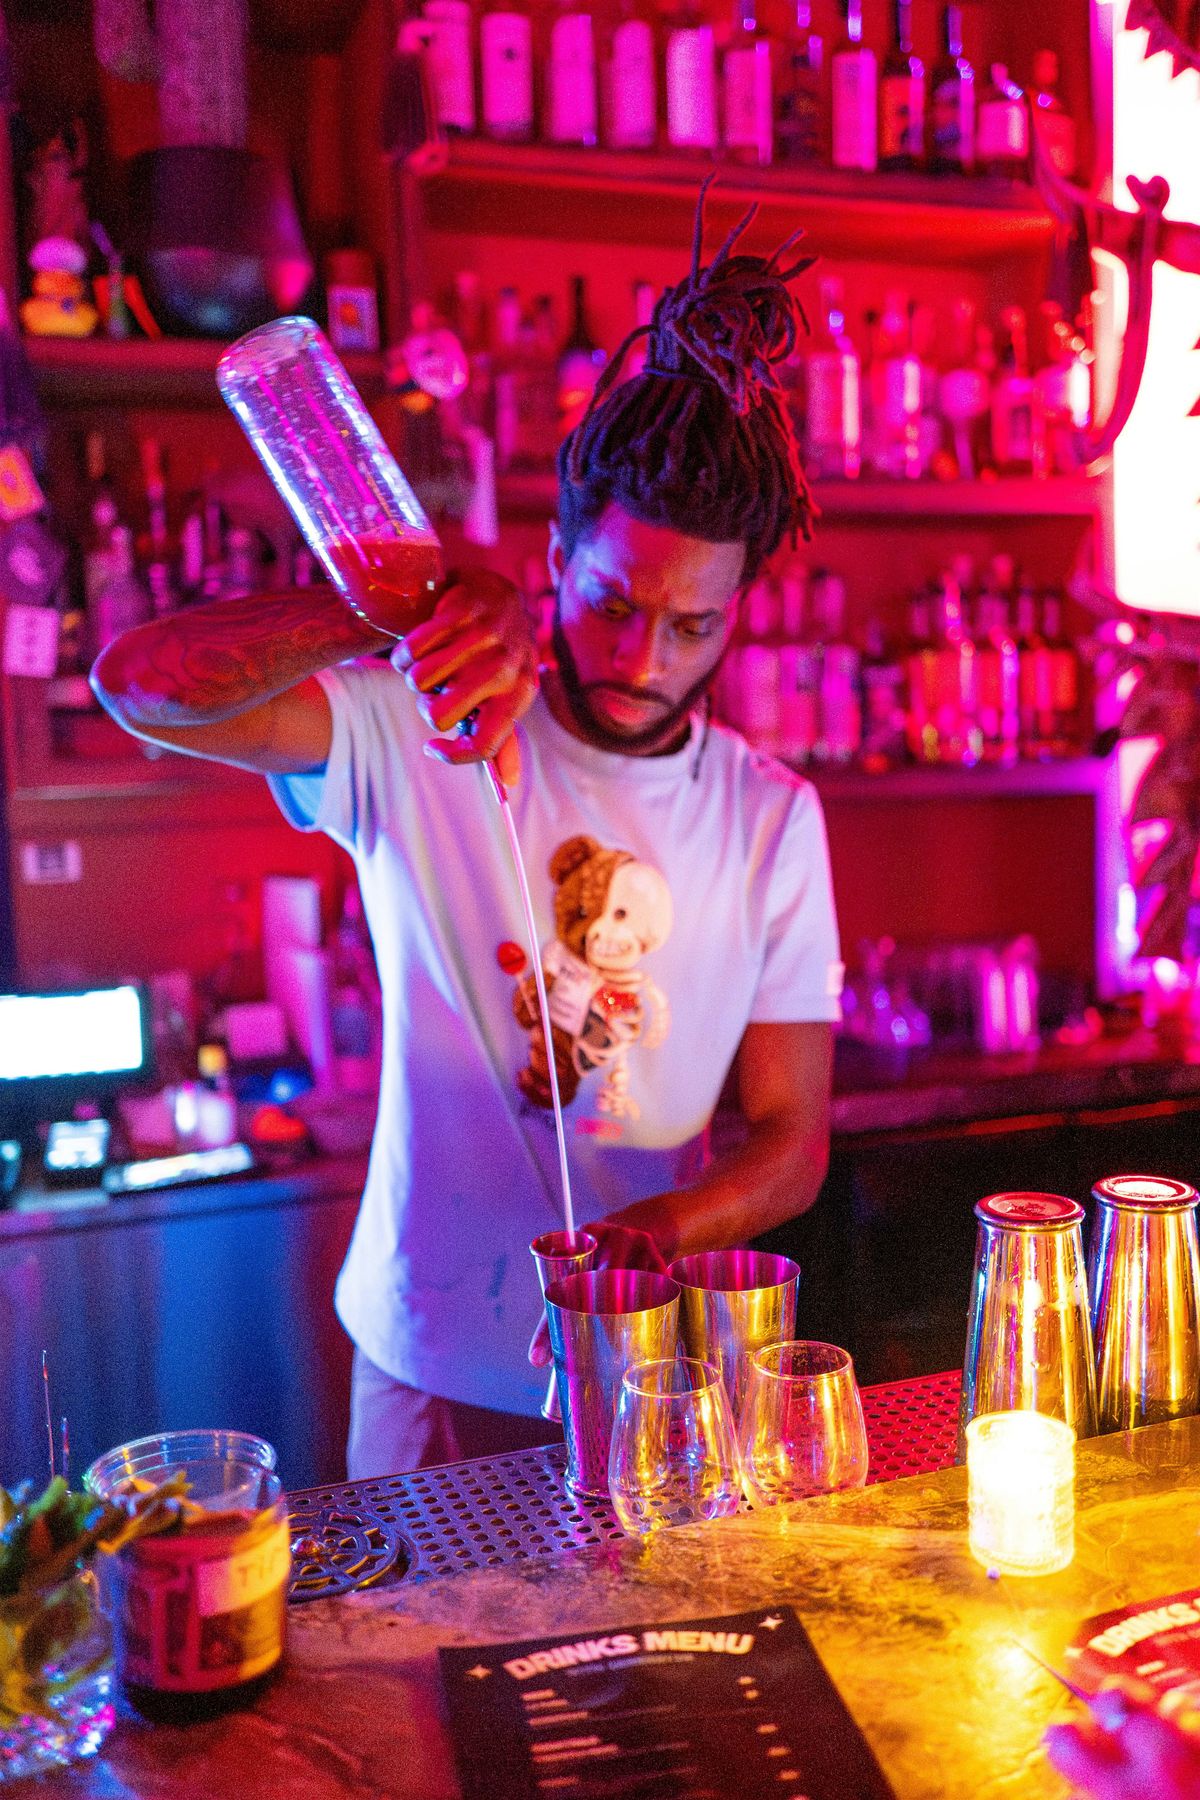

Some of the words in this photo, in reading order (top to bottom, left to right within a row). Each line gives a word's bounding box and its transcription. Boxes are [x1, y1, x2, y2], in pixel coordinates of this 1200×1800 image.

[503, 1634, 639, 1680] DRINKS
[642, 1631, 755, 1655] MENU
[1087, 1602, 1200, 1657] DRINKS
